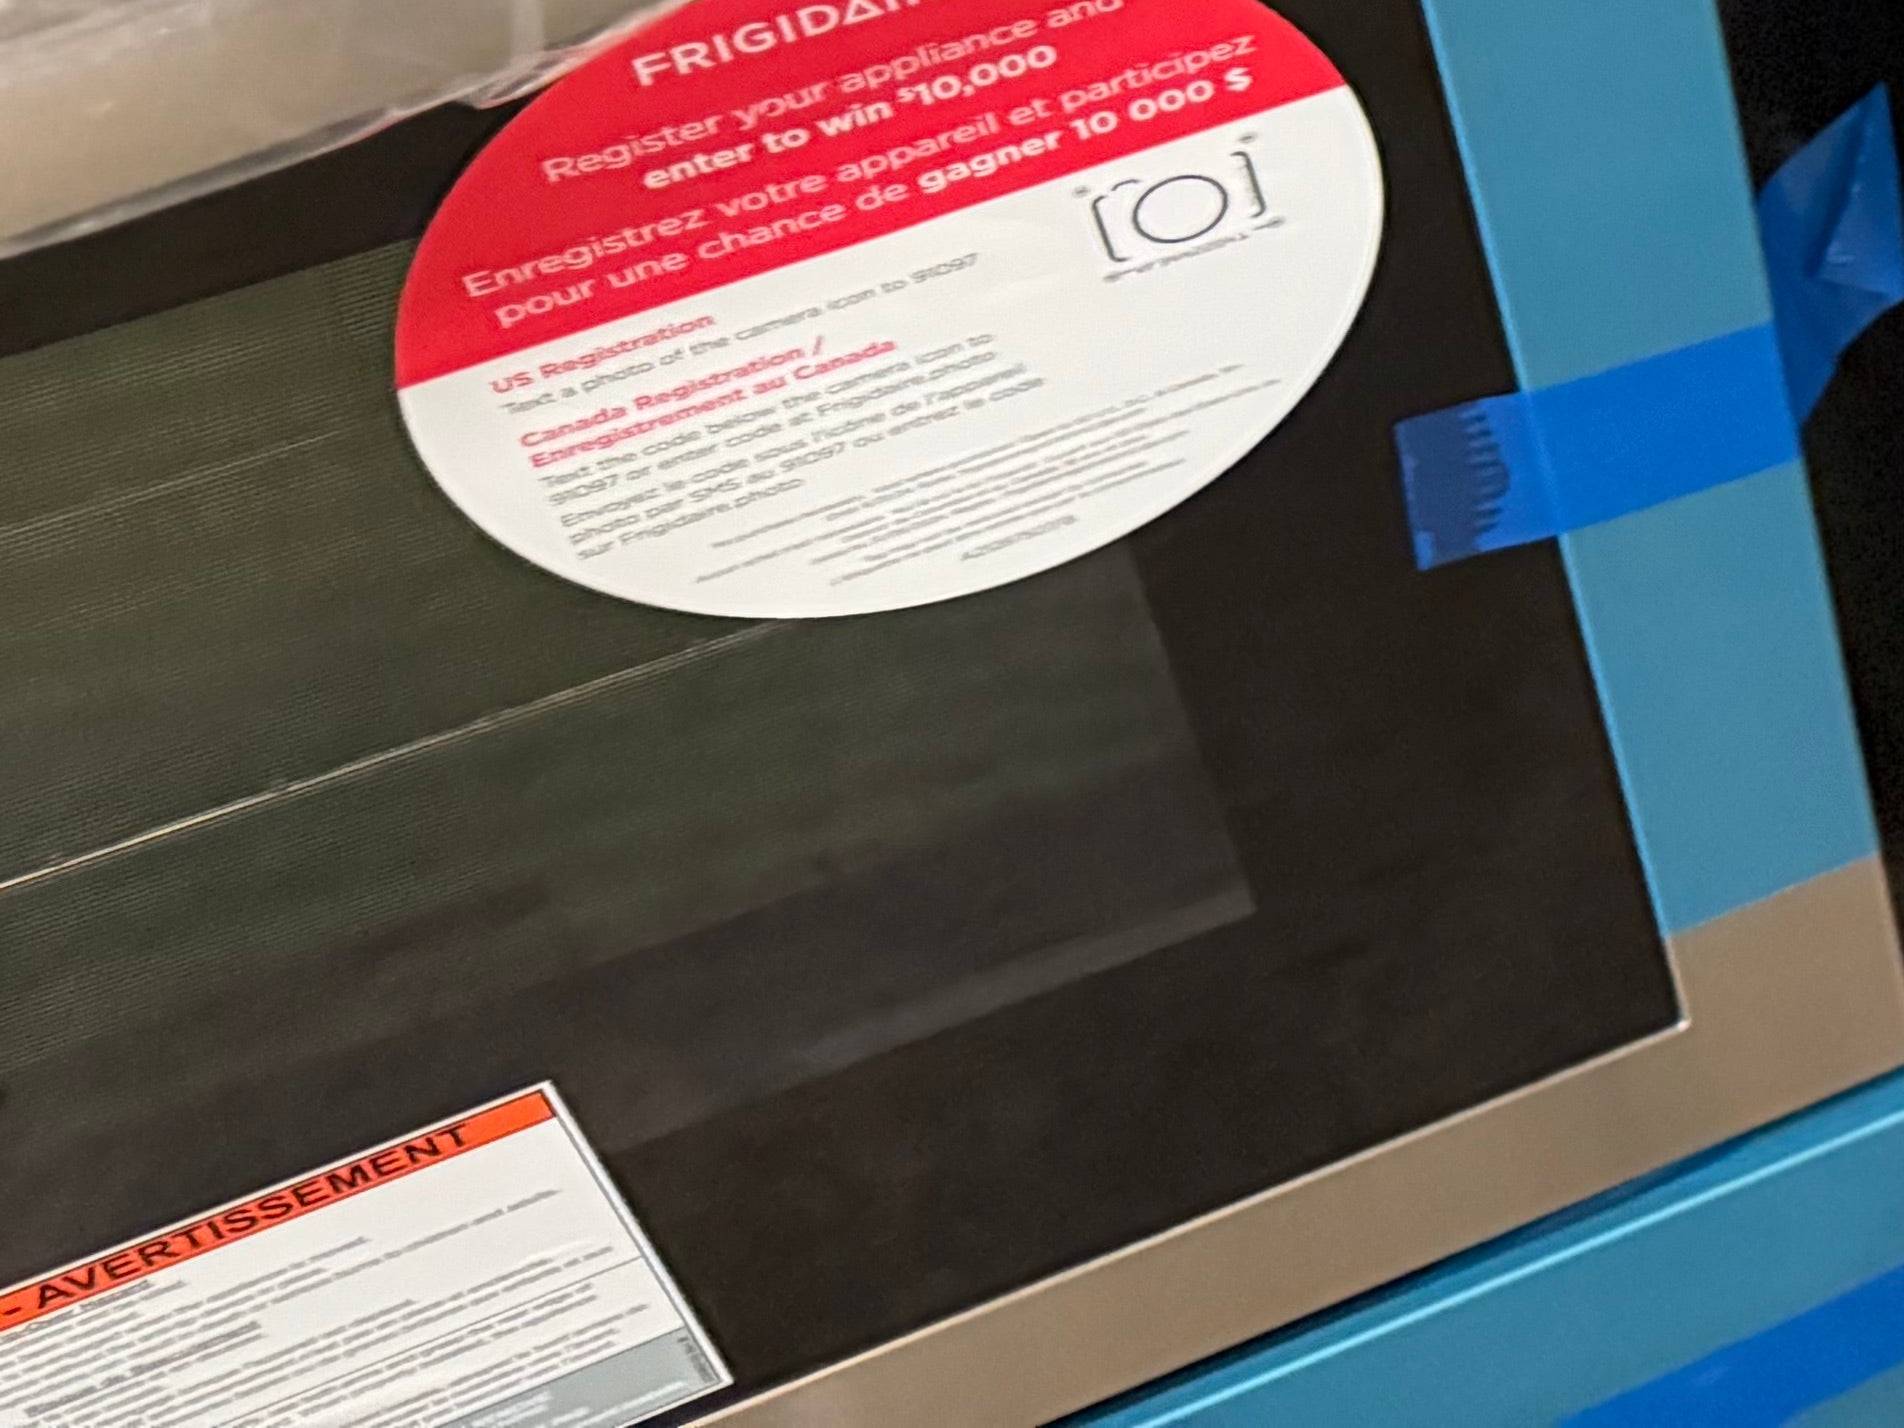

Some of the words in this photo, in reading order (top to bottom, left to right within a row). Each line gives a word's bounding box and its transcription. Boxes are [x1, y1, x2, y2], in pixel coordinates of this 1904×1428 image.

[461, 208, 710, 298] Enregistrez
[714, 172, 828, 217] votre
[836, 113, 999, 182] appareil
[1007, 98, 1053, 127] et
[1058, 35, 1258, 114] participez
[541, 113, 724, 184] Register
[730, 81, 829, 130] your
[839, 18, 1038, 94] appliance
[643, 142, 757, 190] enter
[762, 127, 811, 154] to
[816, 99, 895, 138] win
[898, 45, 1058, 106] $10,000
[494, 281, 595, 329] pour
[607, 253, 690, 289] une
[697, 202, 847, 260] chance
[855, 182, 909, 211] de
[917, 131, 1062, 195] gagner
[1068, 110, 1119, 142] 10
[1128, 79, 1215, 122] 000
[1223, 66, 1253, 93] $
[490, 371, 534, 393] US
[540, 316, 716, 379] Registration
[500, 393, 556, 414] Text
[560, 386, 578, 398] a
[581, 361, 655, 393] photo
[660, 348, 684, 365] of
[689, 337, 729, 356] the
[735, 307, 823, 341] camera
[881, 280, 907, 294] to
[521, 405, 629, 447] Canada
[633, 347, 805, 410] Registration
[813, 334, 825, 356] /
[530, 389, 748, 469] Enregistrement
[753, 375, 787, 395] au
[793, 341, 897, 381] Canada
[641, 430, 702, 456] code
[37, 1121, 469, 1310] AVERTISSEMENT
